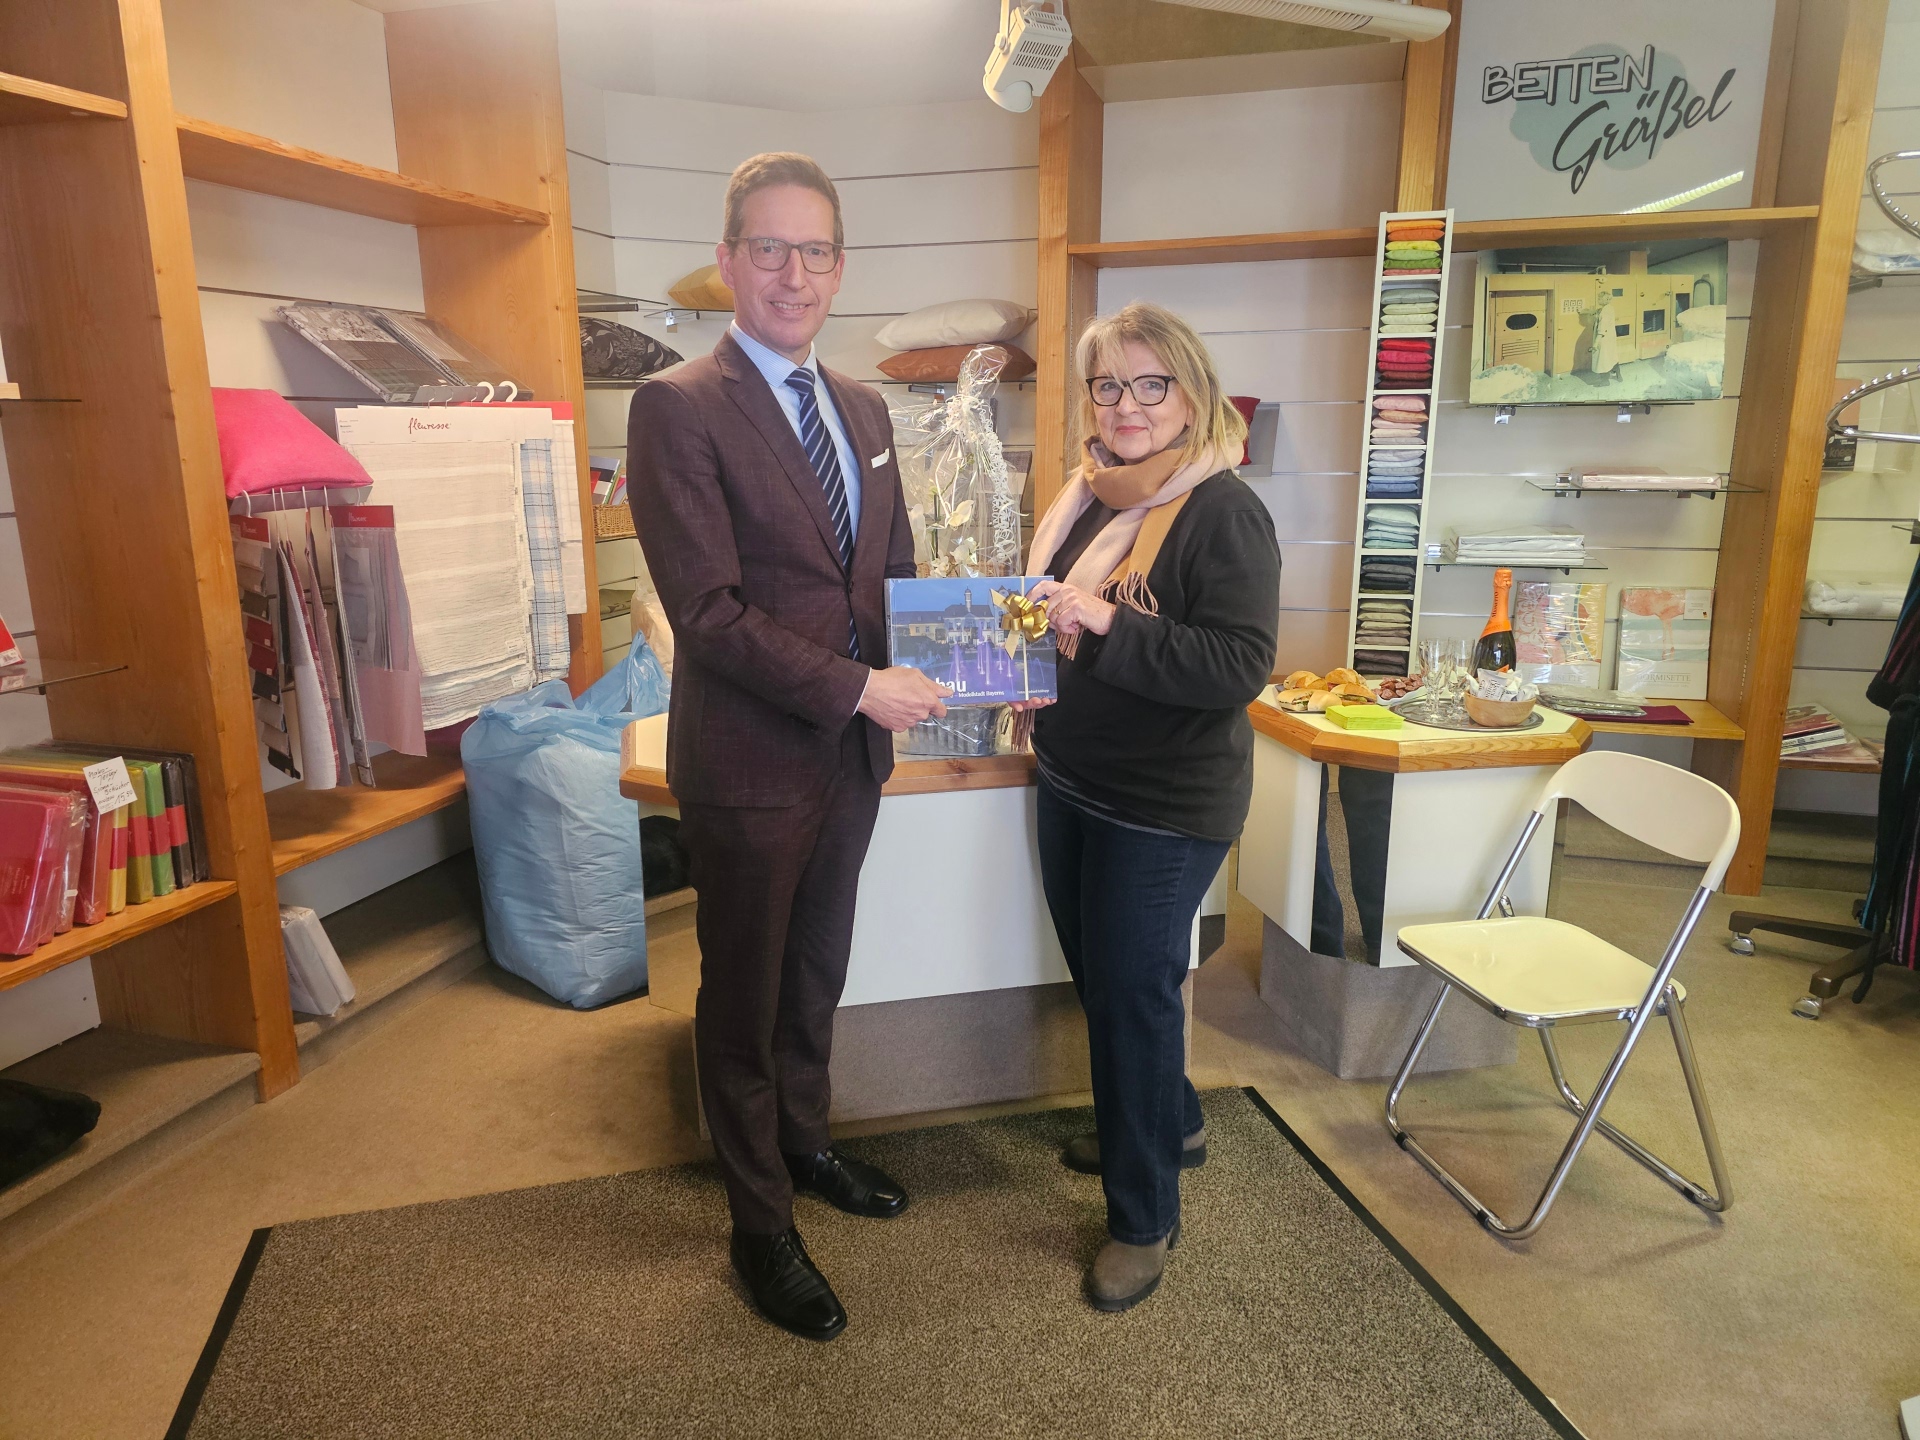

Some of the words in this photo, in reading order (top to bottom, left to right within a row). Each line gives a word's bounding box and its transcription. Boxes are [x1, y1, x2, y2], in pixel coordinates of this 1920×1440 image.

[1482, 44, 1655, 106] BETTEN
[1552, 68, 1736, 194] Gräßel
[408, 418, 449, 434] fleuresse
